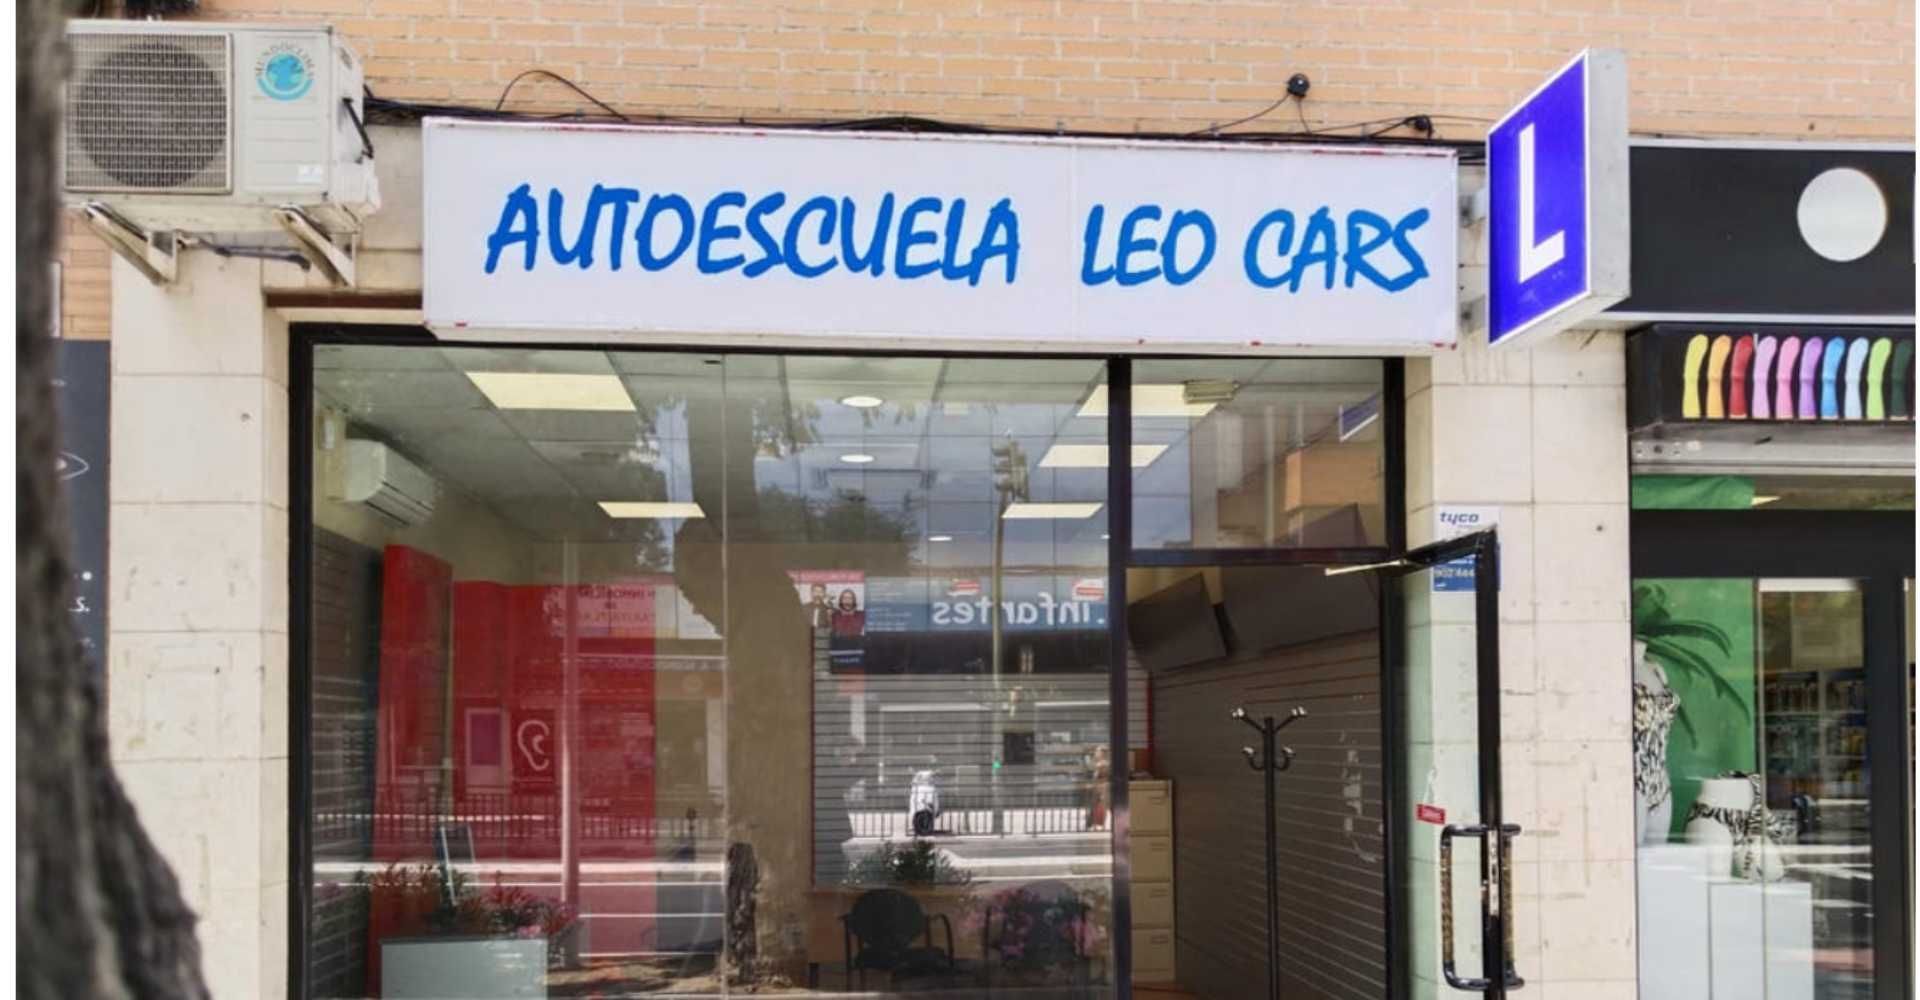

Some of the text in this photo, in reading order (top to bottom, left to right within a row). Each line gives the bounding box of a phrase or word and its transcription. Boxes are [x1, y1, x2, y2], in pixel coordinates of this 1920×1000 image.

[485, 184, 1431, 294] AUTOESCUELA LEO CARS
[1519, 124, 1564, 283] L
[1440, 512, 1479, 525] tyco
